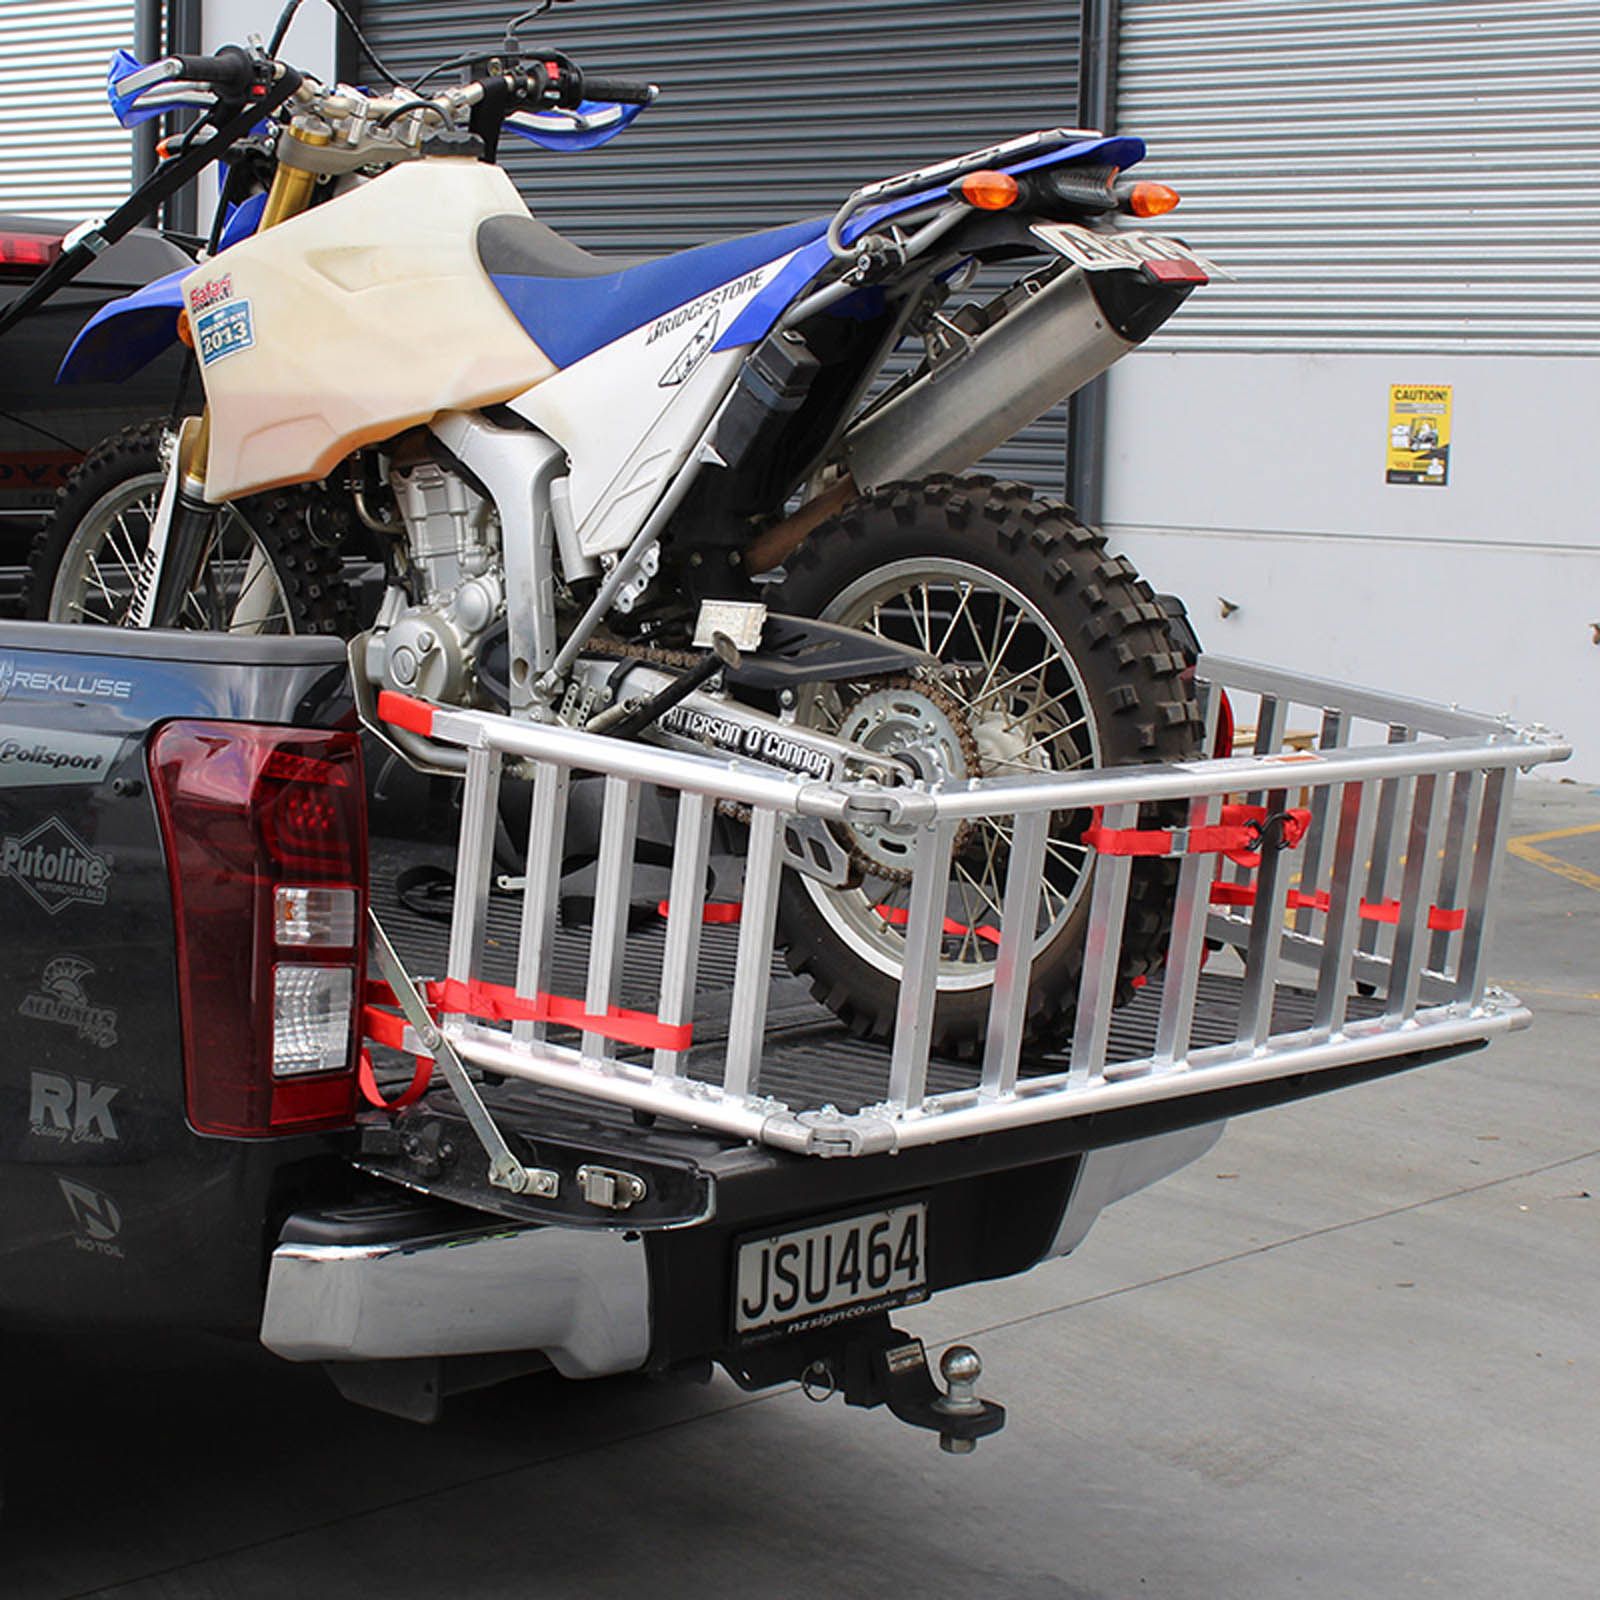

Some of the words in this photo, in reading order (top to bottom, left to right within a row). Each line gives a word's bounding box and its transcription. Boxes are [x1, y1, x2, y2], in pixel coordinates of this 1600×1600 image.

[646, 270, 764, 346] BRIDGESTONE
[203, 322, 248, 355] 2013
[1394, 389, 1448, 401] CAUTION!
[12, 671, 132, 698] REKLUSE
[2, 743, 103, 770] Polisport
[2, 836, 104, 886] Putoline
[29, 1071, 120, 1140] RK
[741, 1213, 920, 1320] JSU464
